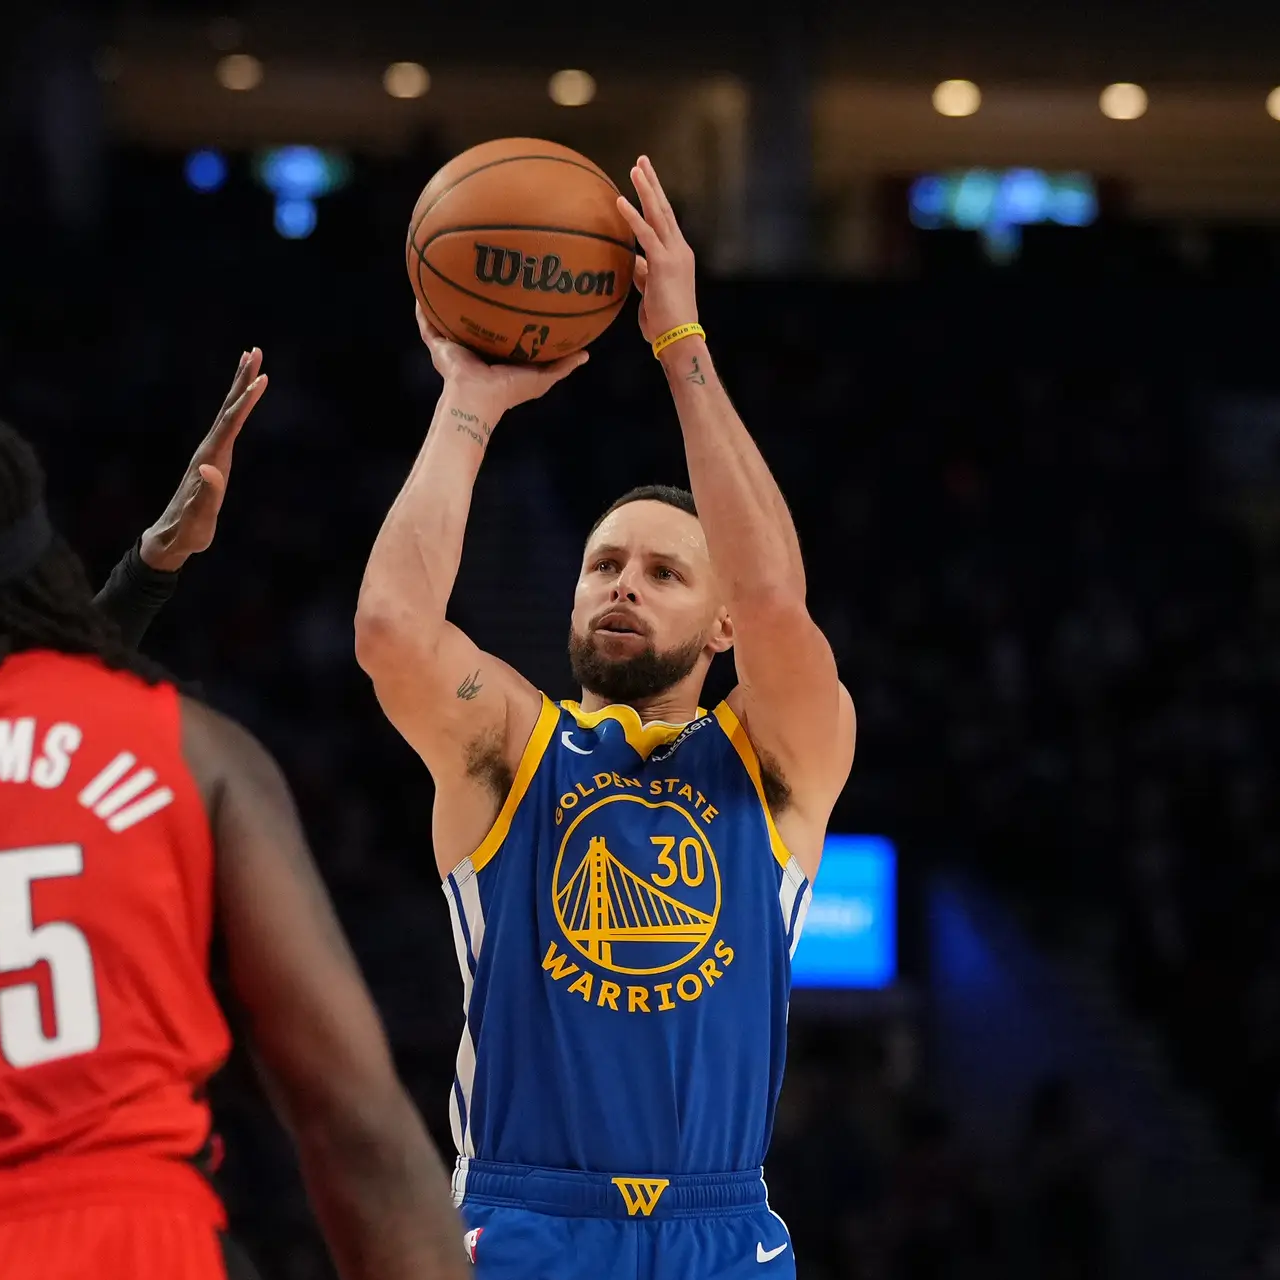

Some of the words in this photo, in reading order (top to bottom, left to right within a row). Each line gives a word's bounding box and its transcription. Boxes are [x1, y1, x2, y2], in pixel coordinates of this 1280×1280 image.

[475, 243, 615, 296] Wilson
[77, 752, 174, 833] III
[555, 771, 642, 825] GOLDEN
[650, 778, 719, 824] STATE
[650, 837, 704, 887] 30
[541, 940, 735, 1012] WARRIORS
